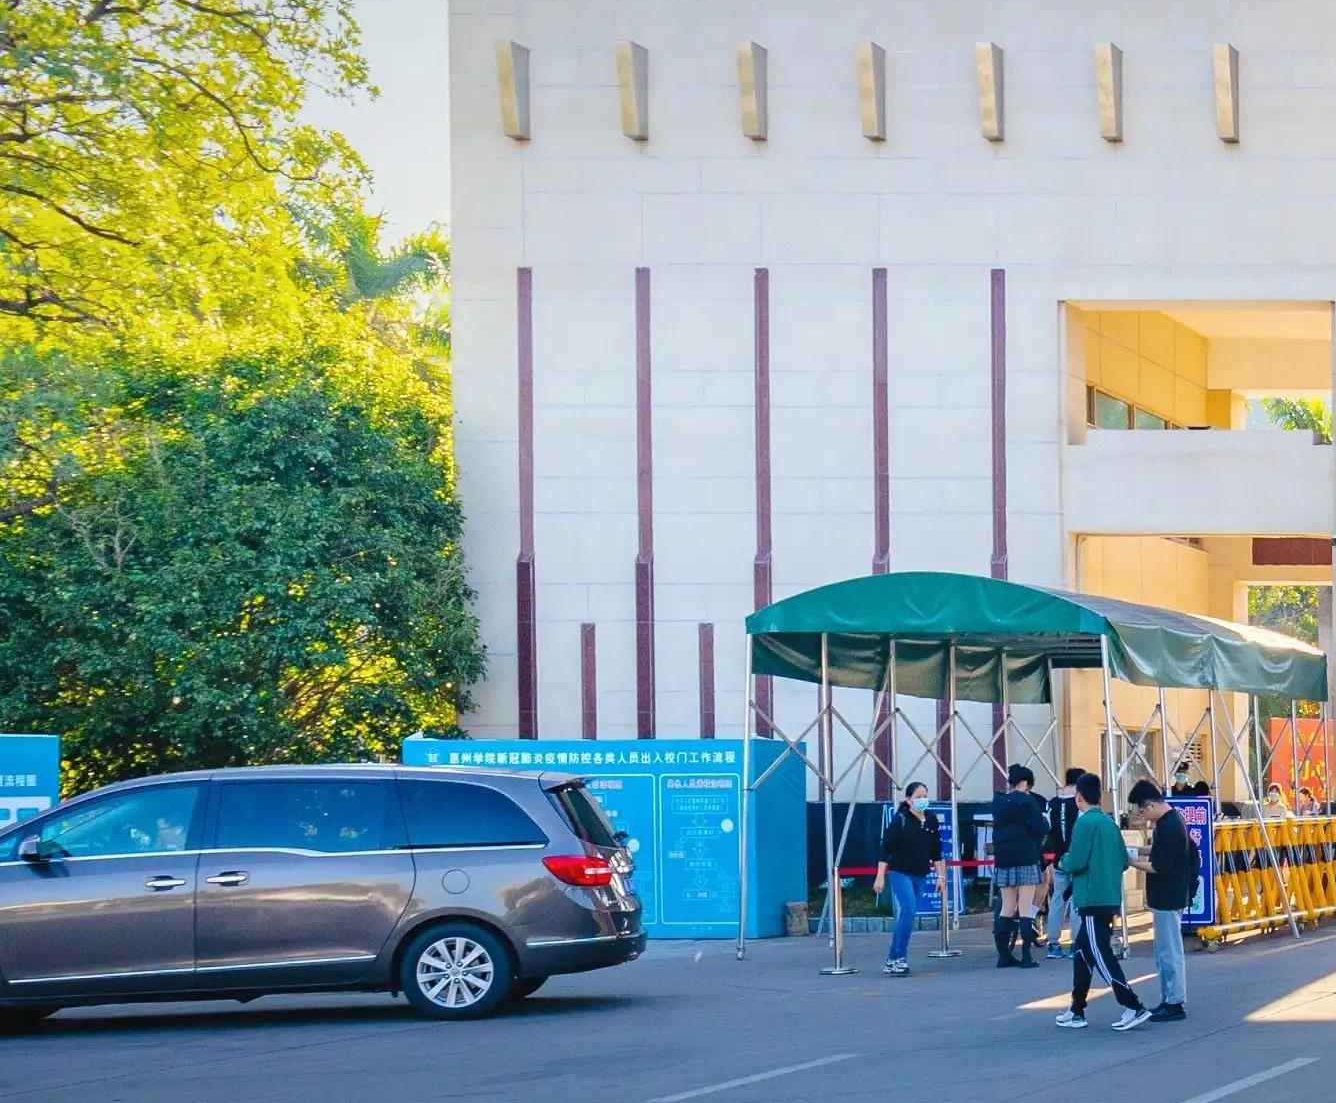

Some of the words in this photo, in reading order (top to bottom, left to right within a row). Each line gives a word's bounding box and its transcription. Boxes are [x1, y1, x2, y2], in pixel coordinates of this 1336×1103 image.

[449, 750, 736, 766] 惠州学院新冠肺炎疫情防控各类人员出入校门工作流程
